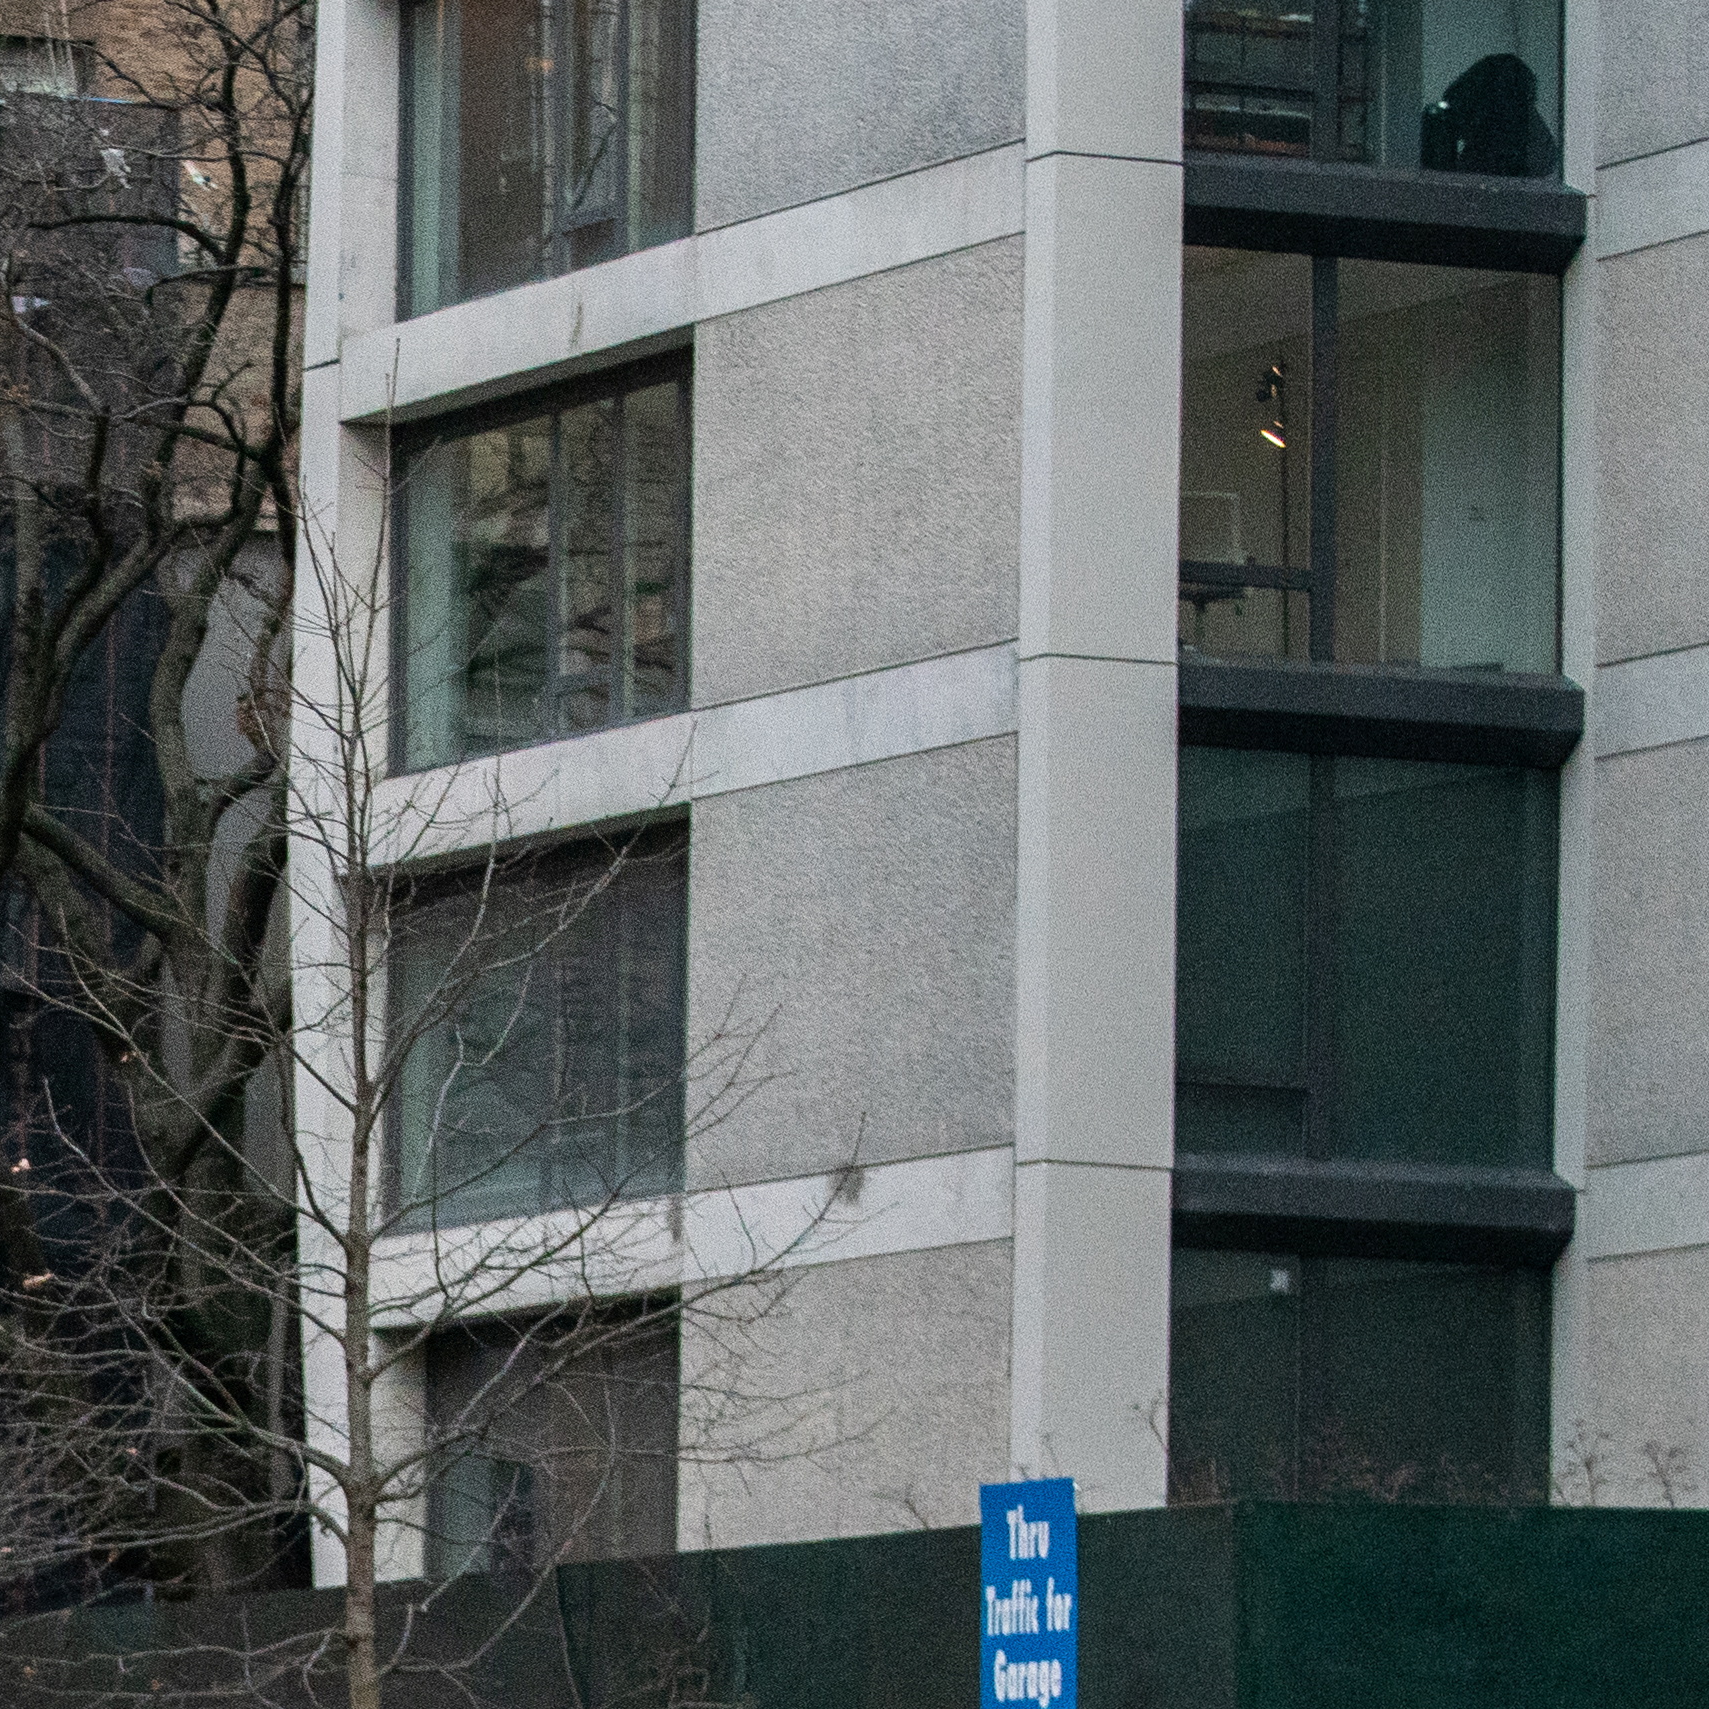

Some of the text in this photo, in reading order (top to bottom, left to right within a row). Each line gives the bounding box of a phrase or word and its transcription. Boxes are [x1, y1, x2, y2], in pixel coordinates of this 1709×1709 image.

[1006, 1504, 1050, 1560] Thru
[985, 1577, 1073, 1636] Traffic for
[993, 1649, 1062, 1709] Garage
